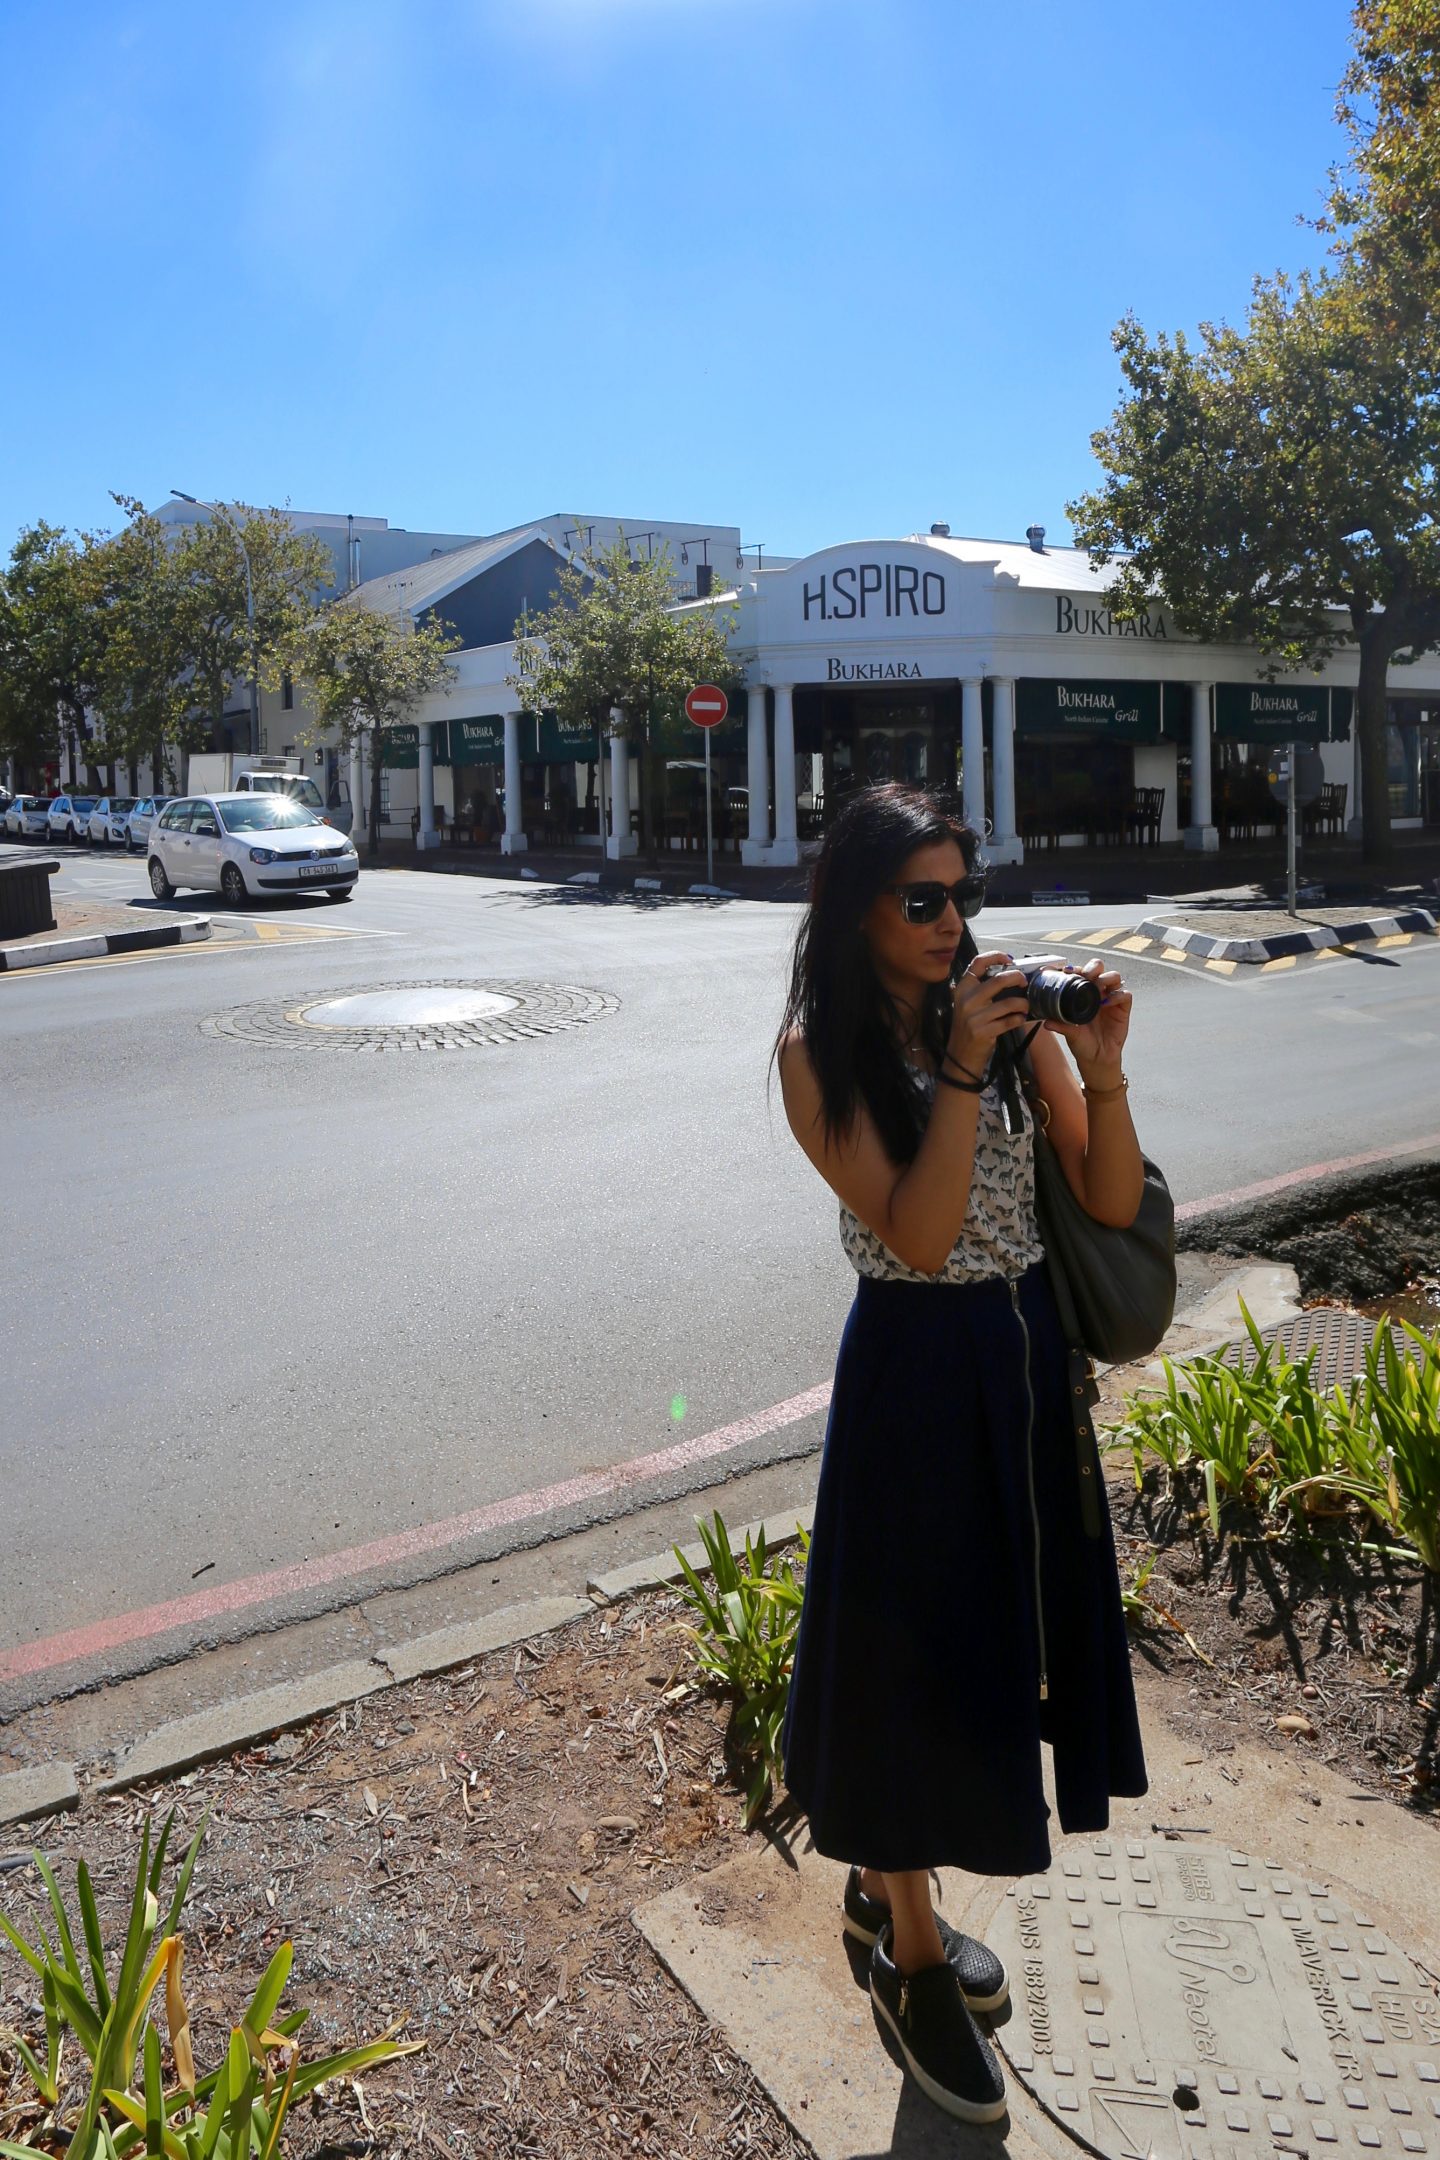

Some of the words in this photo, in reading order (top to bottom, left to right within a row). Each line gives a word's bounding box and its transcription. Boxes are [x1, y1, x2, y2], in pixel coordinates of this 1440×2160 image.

[1055, 595, 1167, 639] BUKHARA
[827, 657, 922, 681] BUKHARA
[1057, 685, 1116, 709] BUKHARA
[1250, 691, 1298, 711] BUKHARA
[1114, 709, 1139, 722] Grill
[1296, 710, 1318, 722] Grill
[462, 723, 494, 739] BUKHARA
[1017, 1898, 1041, 1949] SANS
[1023, 1955, 1054, 2055] 1882/2003
[1289, 1925, 1350, 2042] MAVERICK
[1333, 2050, 1364, 2082] TR
[1177, 1969, 1227, 2067] Neotel
